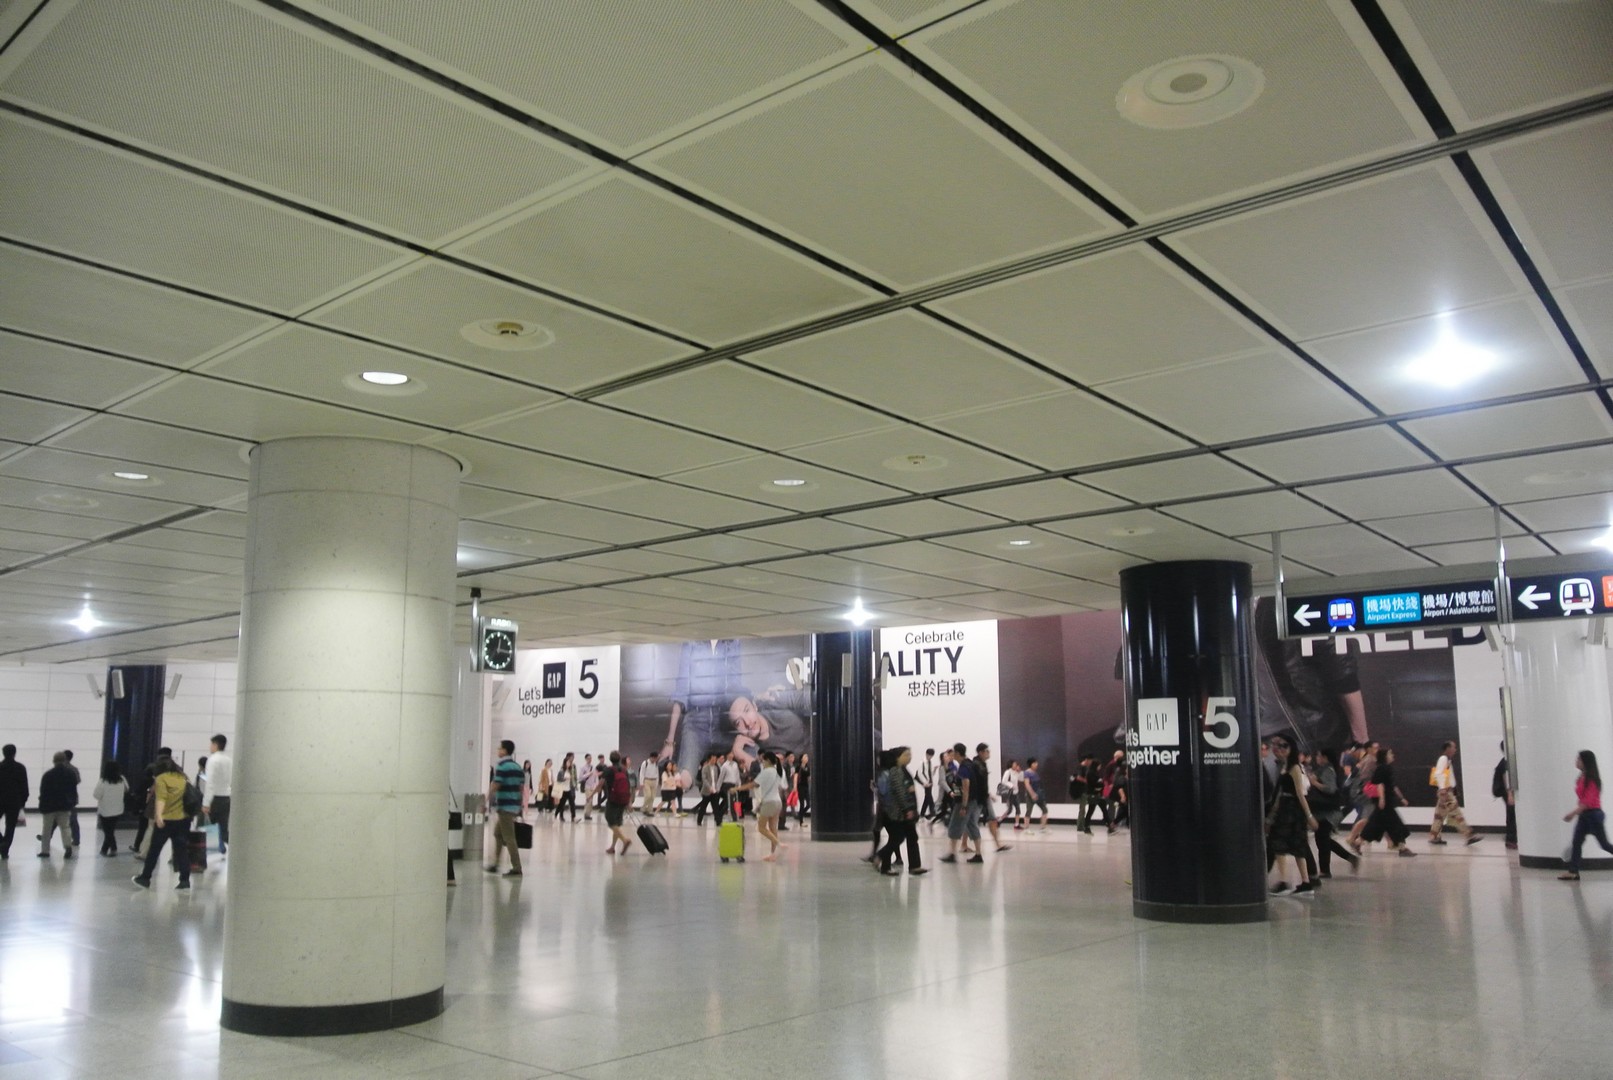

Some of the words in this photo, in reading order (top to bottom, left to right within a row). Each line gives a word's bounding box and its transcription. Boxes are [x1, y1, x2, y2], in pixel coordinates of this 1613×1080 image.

[1367, 613, 1390, 622] Airport
[1391, 611, 1417, 620] Express
[1423, 609, 1445, 618] Airport
[905, 629, 964, 645] Celebrate
[518, 687, 541, 702] Let's
[546, 672, 562, 689] GAP
[907, 678, 966, 698] 忠於自我
[522, 700, 566, 718] together
[1146, 713, 1168, 731] GAP
